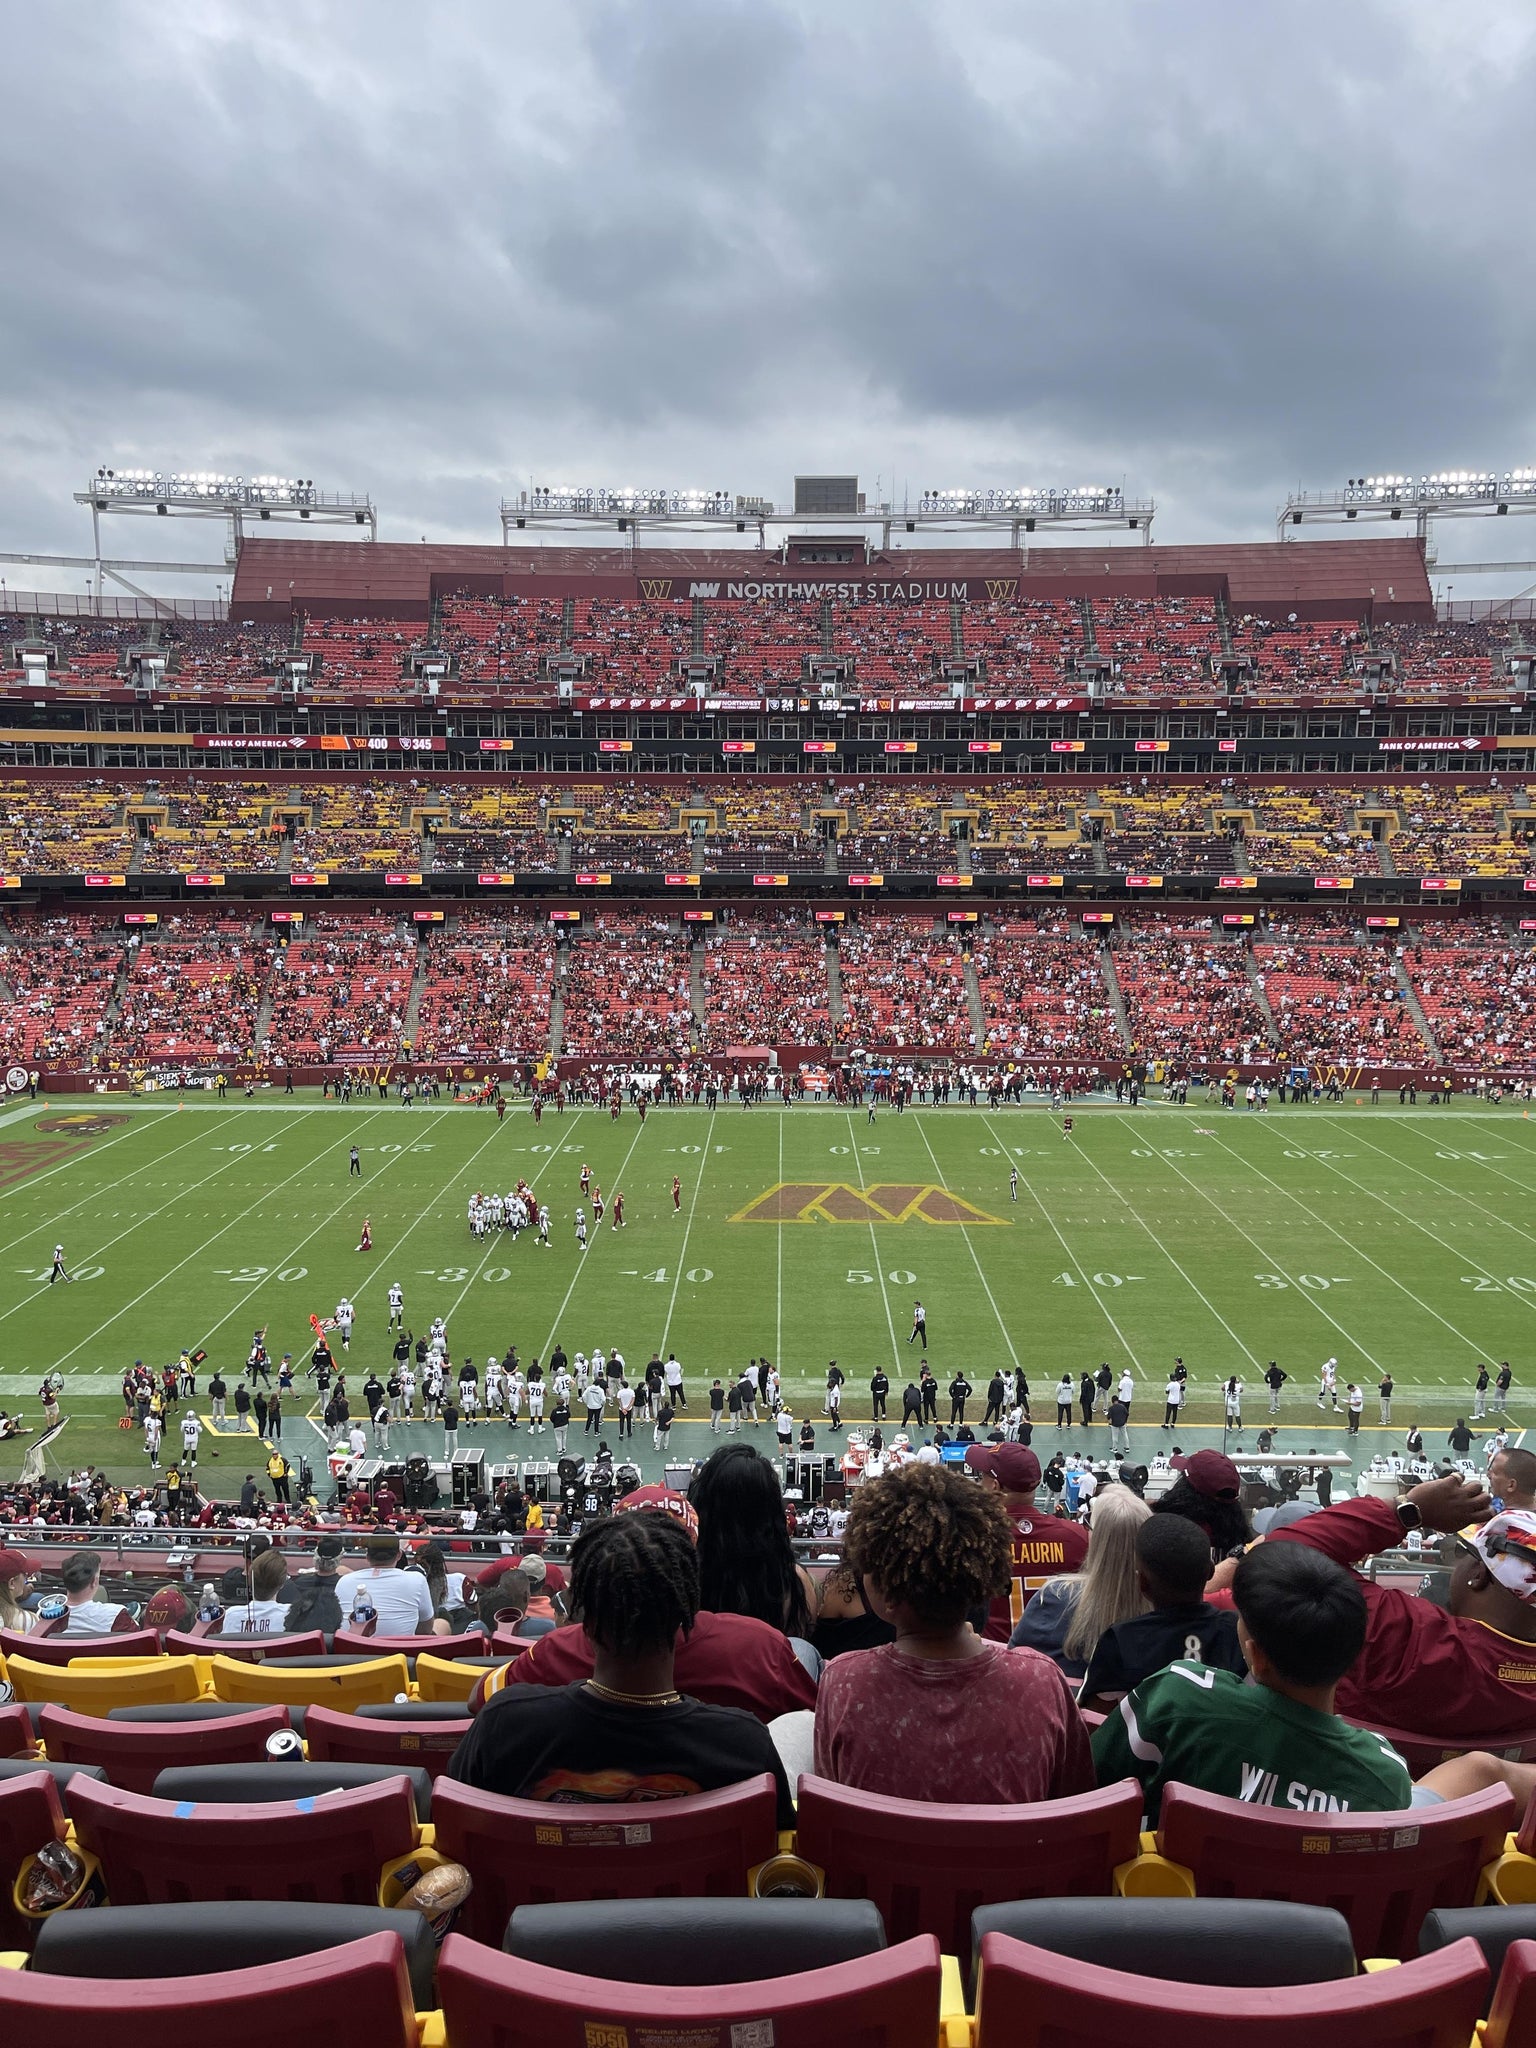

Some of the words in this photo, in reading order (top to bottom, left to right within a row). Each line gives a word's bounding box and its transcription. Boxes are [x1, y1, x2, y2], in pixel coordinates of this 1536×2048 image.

[689, 582, 721, 598] NW
[727, 582, 863, 599] NORTHWEST
[866, 582, 968, 599] STADIUM
[781, 699, 794, 708] 24
[817, 699, 840, 711] 1:59
[866, 699, 878, 708] 41
[208, 739, 234, 747] BANK
[247, 740, 288, 748] AMERICA
[367, 738, 388, 750] 400
[412, 738, 432, 750] 345
[1404, 742, 1417, 750] OF
[1418, 742, 1460, 750] AMERICA
[88, 1077, 118, 1085] FIVE
[235, 1072, 269, 1080] AMPS
[228, 1266, 309, 1282] 20
[436, 1267, 512, 1282] 30
[642, 1268, 714, 1283] 40
[846, 1269, 917, 1285] 50
[1052, 1272, 1123, 1288] 40
[1254, 1274, 1332, 1290] 30
[340, 1310, 350, 1318] 74
[463, 1386, 473, 1395] 16
[530, 1387, 542, 1396] 70
[120, 1418, 130, 1428] 20
[184, 1426, 195, 1435] 50
[1394, 1460, 1401, 1470] 9
[585, 1498, 598, 1512] 98
[272, 1522, 286, 1532] 23
[180, 1536, 192, 1545] 89
[1009, 1541, 1064, 1564] LAURIN
[240, 1619, 271, 1633] TAYLOR
[1184, 1634, 1201, 1660] 8
[1238, 1761, 1350, 1813] WILSON
